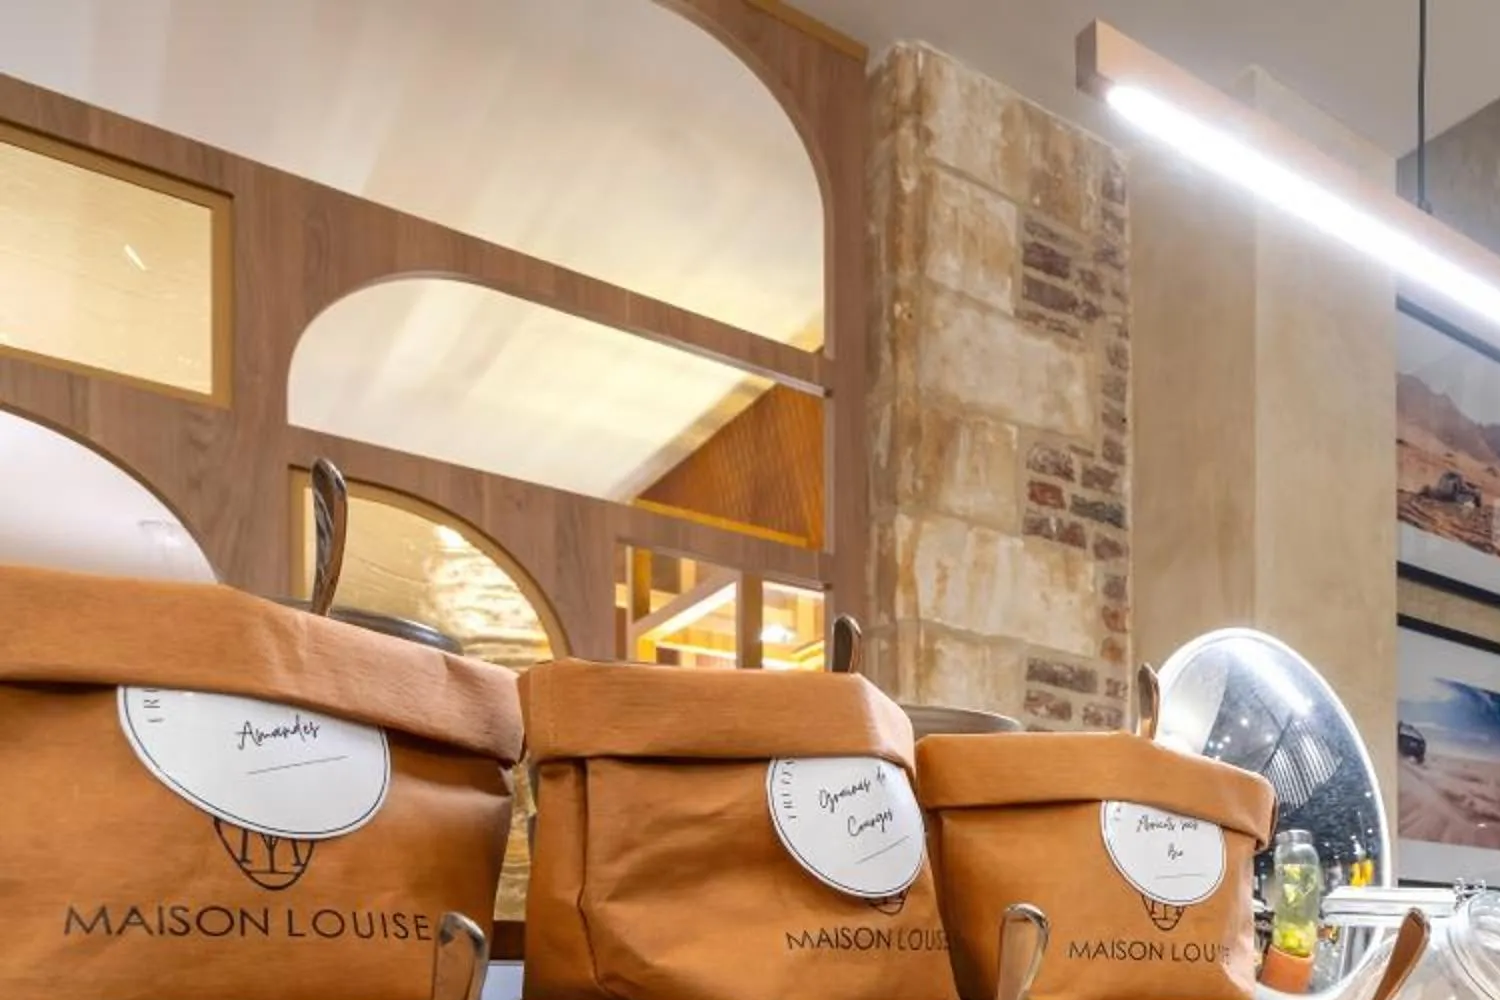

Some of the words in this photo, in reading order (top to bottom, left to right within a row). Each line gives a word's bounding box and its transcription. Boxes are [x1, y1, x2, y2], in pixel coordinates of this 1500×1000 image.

[64, 904, 269, 937] MAISON
[287, 908, 433, 941] LOUISE
[785, 927, 892, 951] MAISON
[1069, 940, 1165, 961] MAISON
